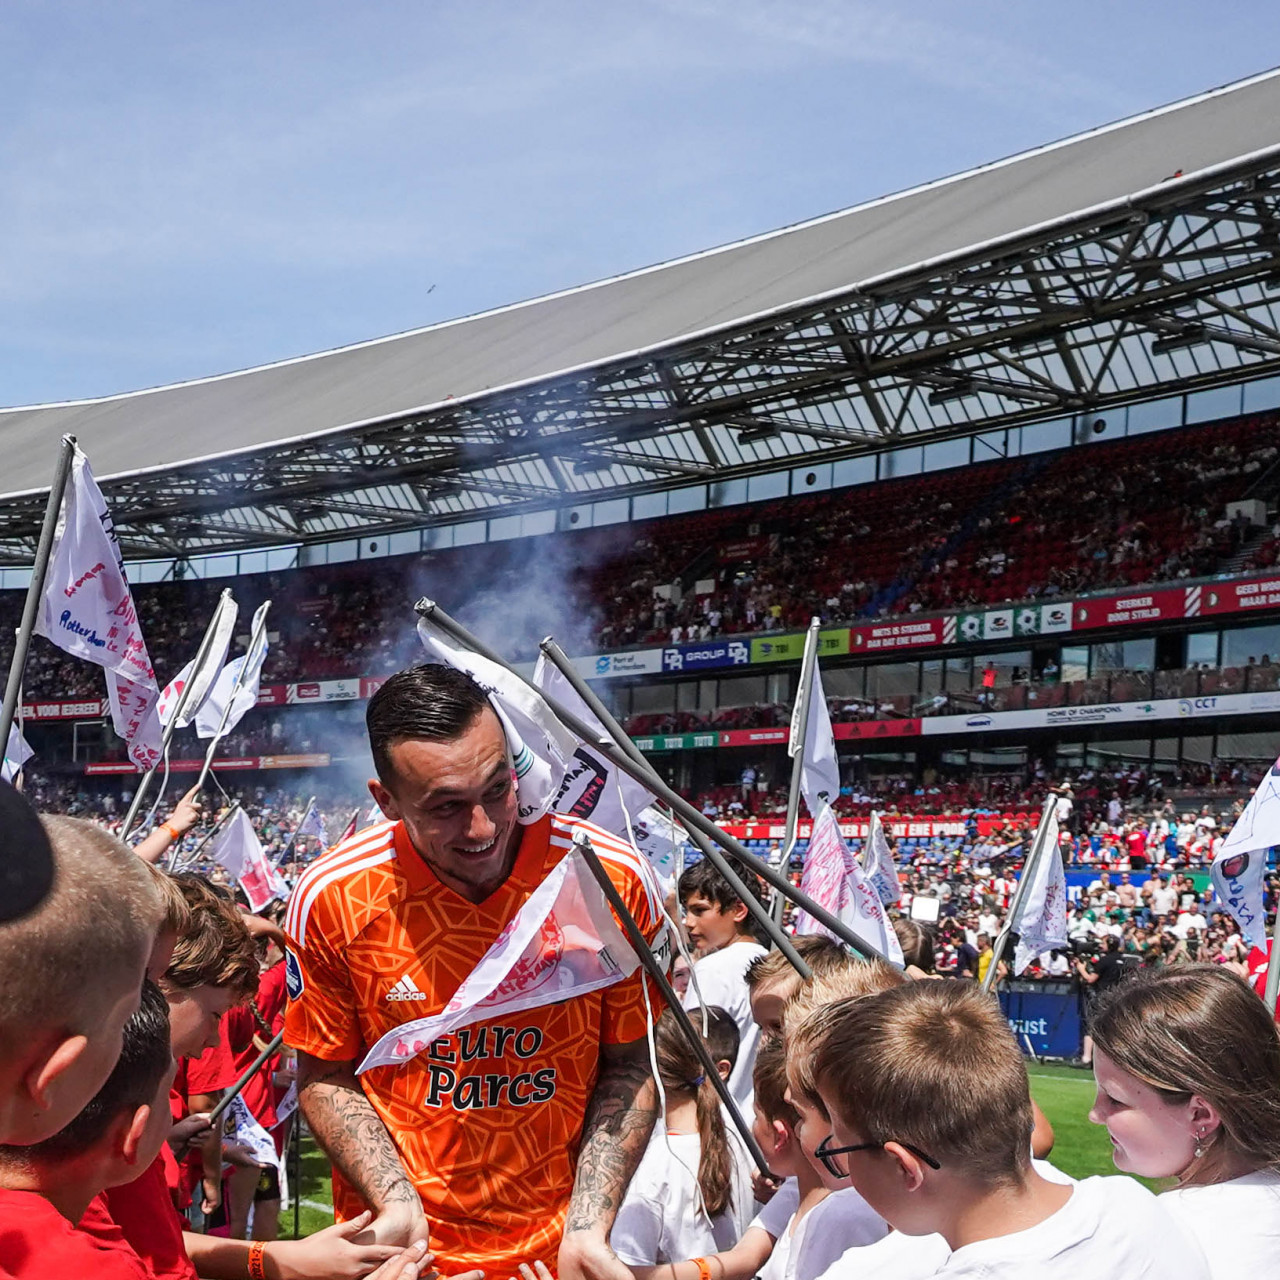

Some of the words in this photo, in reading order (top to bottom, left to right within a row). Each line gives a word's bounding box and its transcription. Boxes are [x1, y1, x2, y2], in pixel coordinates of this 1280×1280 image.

[686, 649, 725, 662] GROUP
[1195, 697, 1217, 709] CCT
[799, 825, 811, 837] IS
[385, 991, 426, 1001] adidas
[429, 1025, 543, 1064] Euro
[425, 1063, 576, 1111] Parcs
